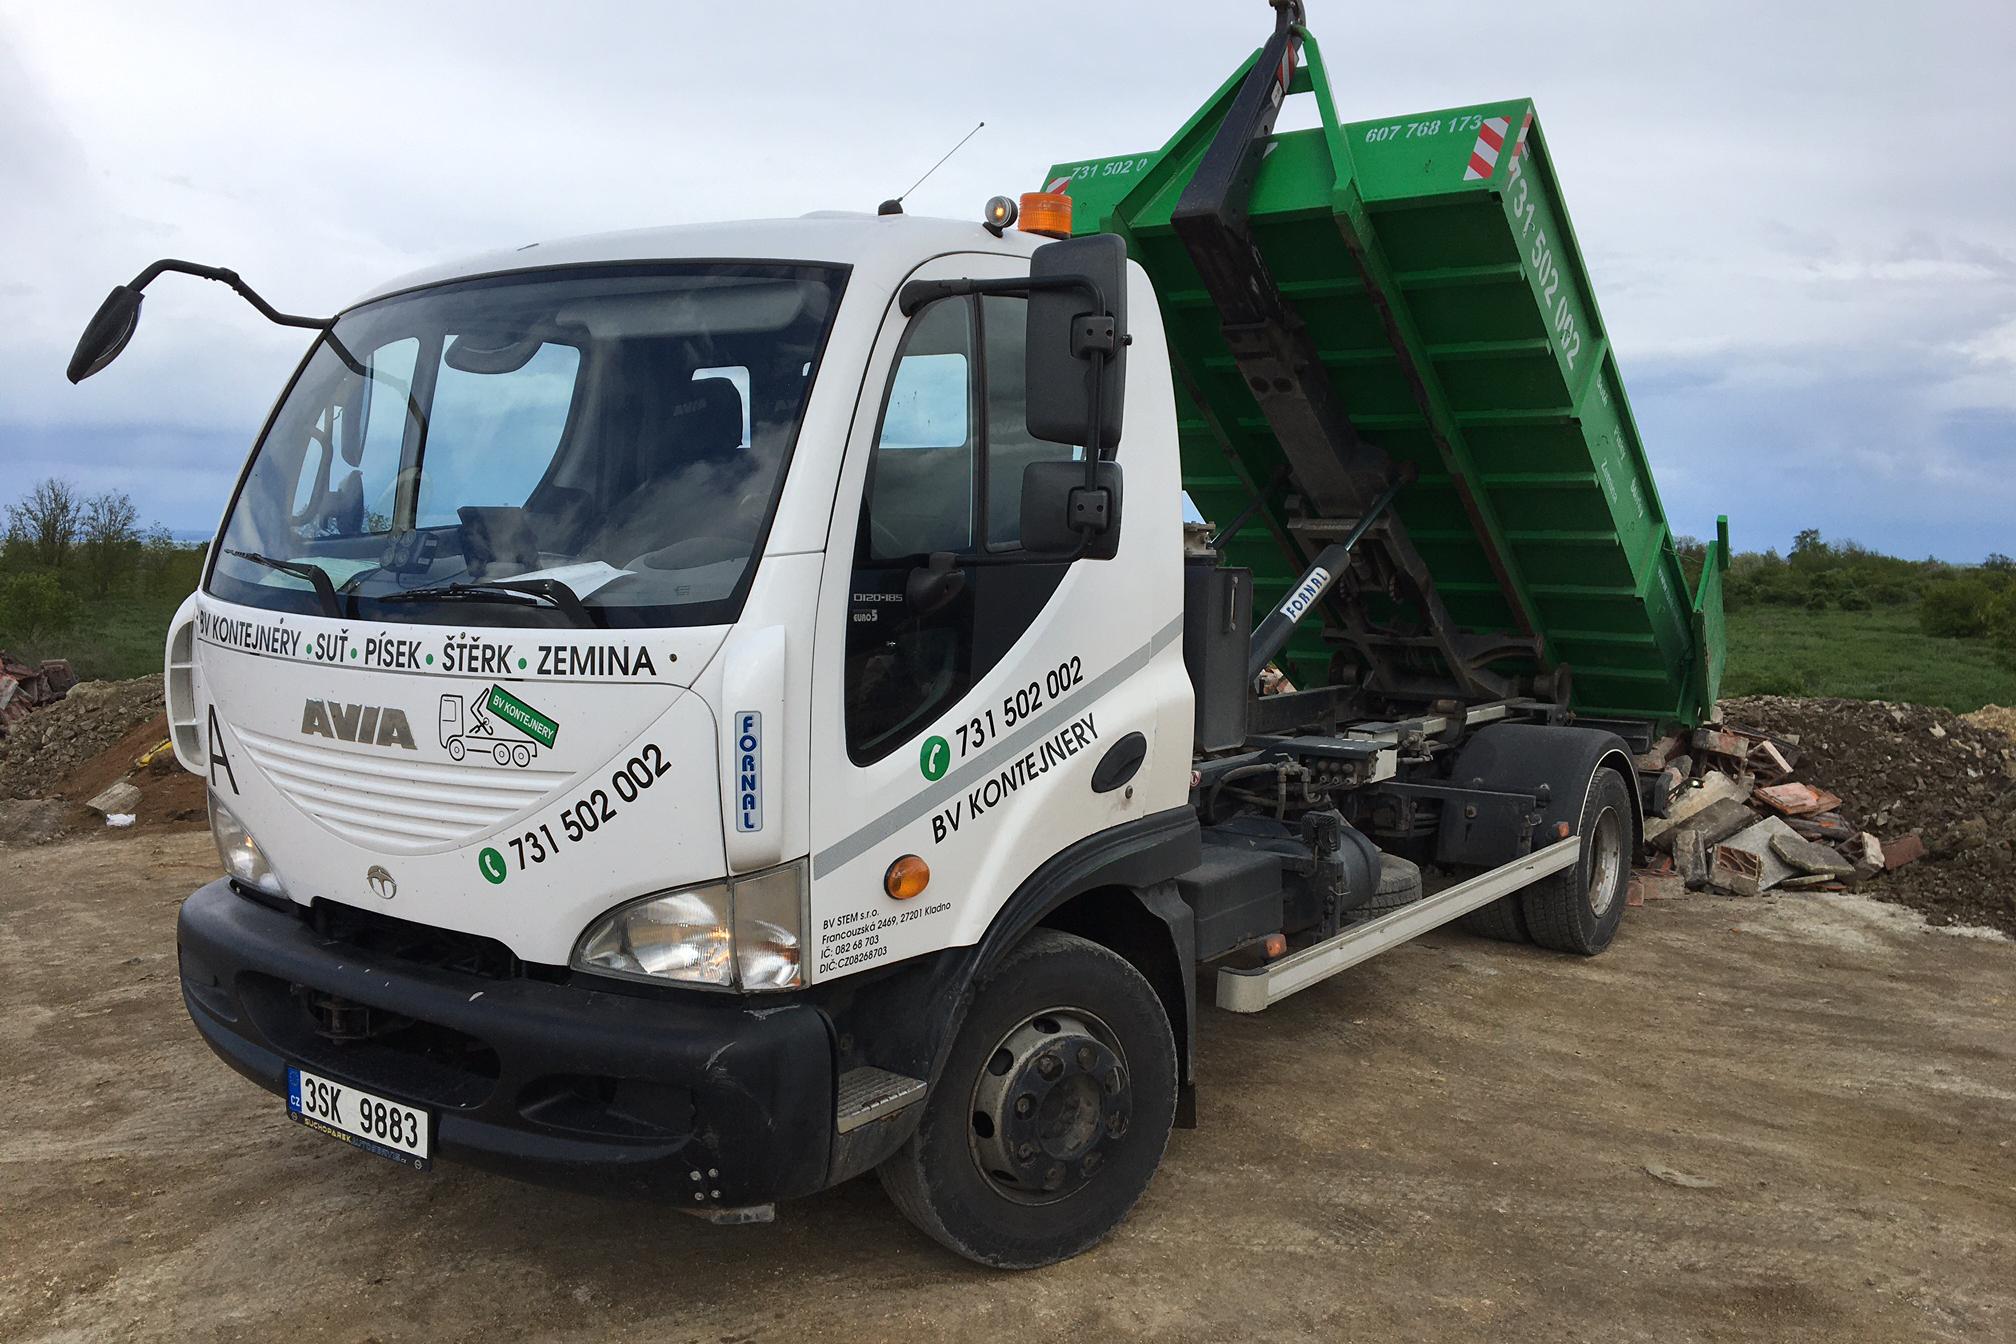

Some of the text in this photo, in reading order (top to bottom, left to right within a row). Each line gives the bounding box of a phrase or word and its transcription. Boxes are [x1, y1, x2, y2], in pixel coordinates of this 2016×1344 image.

[1365, 114, 1483, 143] 607 768 173
[1071, 164, 1099, 180] 731
[1102, 160, 1134, 177] 502
[1507, 157, 1580, 370] 731 502 002
[1286, 572, 1328, 619] FORNAL
[315, 629, 349, 662] SUŤ
[364, 631, 422, 669] PÍSEK
[442, 635, 513, 674] ŠTĚRK
[537, 645, 657, 676] ZEMINA
[301, 697, 418, 751] AVIA
[493, 695, 554, 740] BV KONTEJNERY
[956, 656, 1084, 757] 731 502 002
[739, 715, 757, 829] FORNAL
[932, 712, 1099, 844] BV KONTEJNERY
[508, 743, 673, 871] 731 502 002
[821, 902, 952, 945] Francouzská 2469, 27201 Kladno
[823, 908, 880, 930] BV STEM s.r.o.
[820, 934, 880, 960] IČ: 082 68 703
[290, 1094, 301, 1107] CZ
[304, 1077, 418, 1149] 3SK 9883
